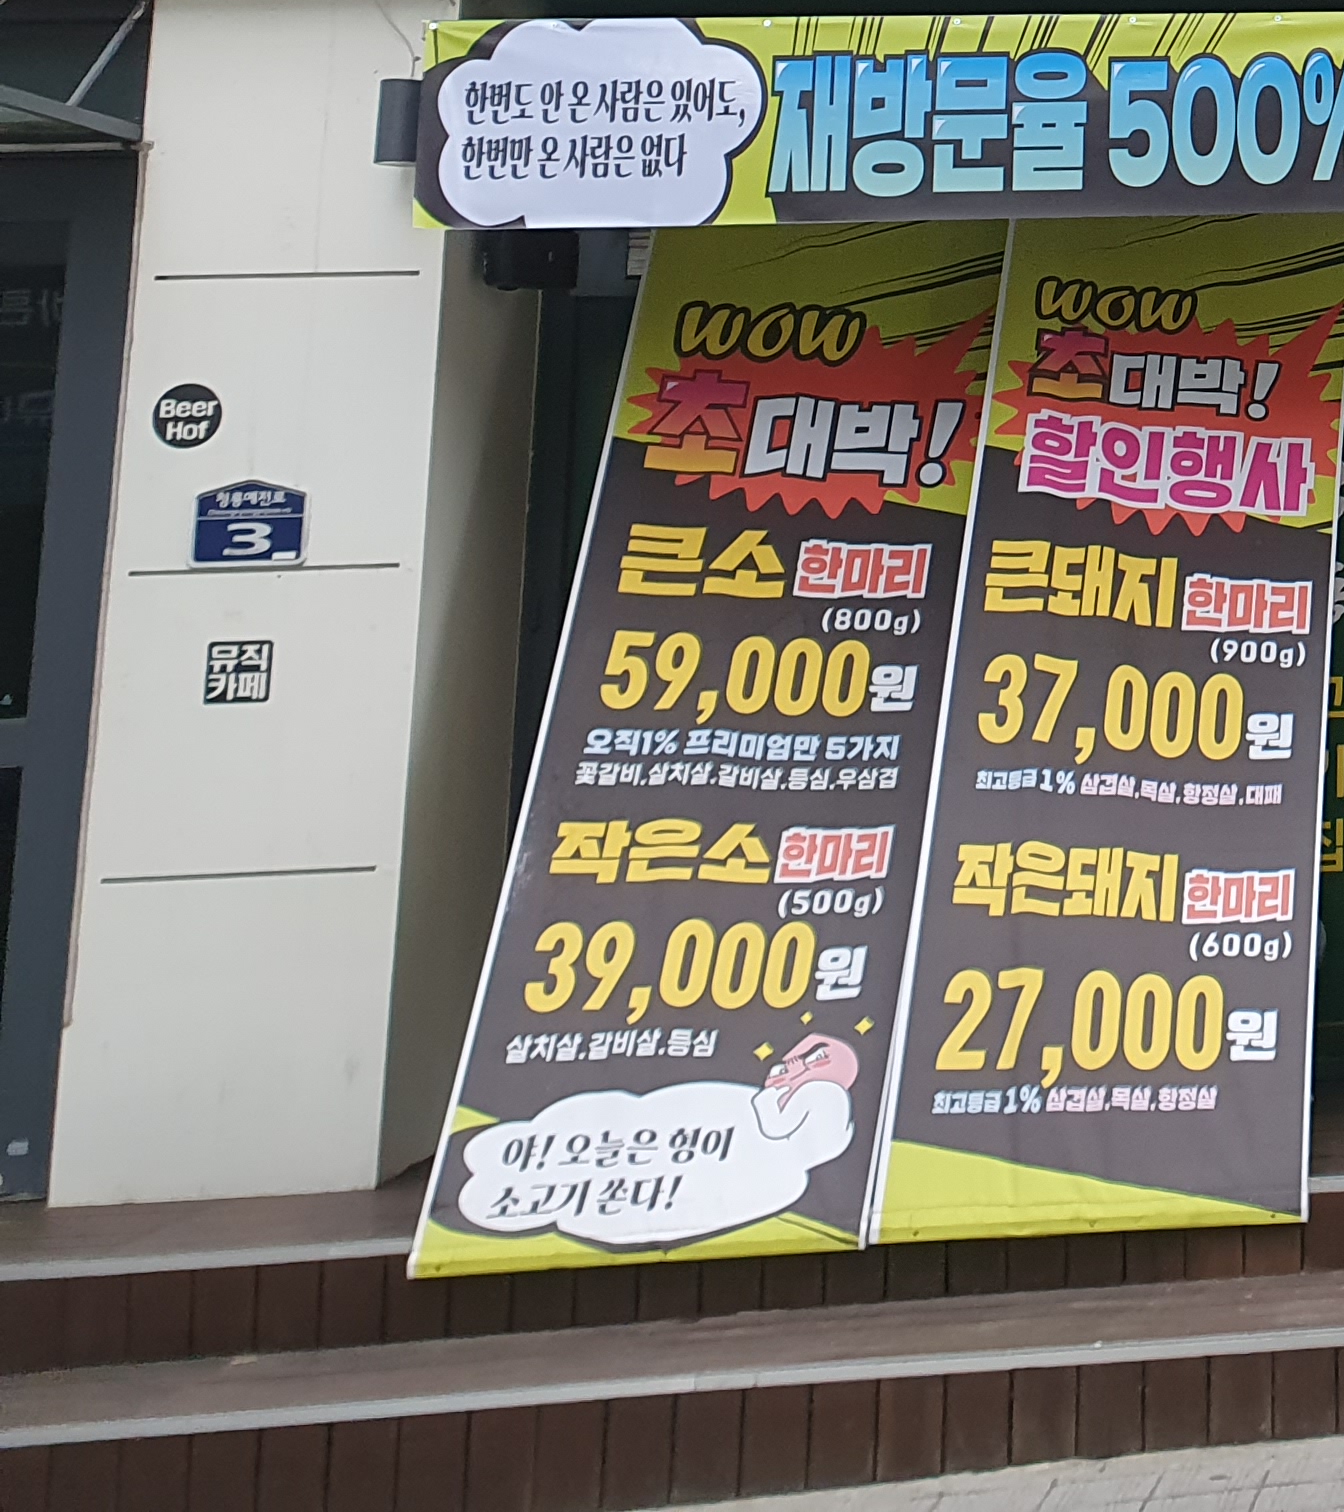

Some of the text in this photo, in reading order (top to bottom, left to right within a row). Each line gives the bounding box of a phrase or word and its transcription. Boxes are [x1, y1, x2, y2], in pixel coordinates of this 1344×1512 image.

[464, 80, 534, 126] 한번도
[539, 79, 564, 124] 안
[567, 80, 592, 124] 온
[592, 78, 667, 124] 사람은
[766, 48, 1089, 199] 재방문율
[461, 132, 688, 181] 한번만 온 사람은 없다
[1027, 327, 1281, 421] 초대박!
[158, 397, 219, 420] Beer
[165, 419, 210, 442] Hof
[643, 370, 966, 488] 초대박!
[1018, 409, 1317, 516] 할인행사
[222, 521, 273, 557] 3
[617, 522, 933, 599] 큰소 한마리
[983, 539, 1314, 635] 큰돼지 한마리
[821, 605, 922, 637] (800g)
[209, 642, 270, 672] 뮤직
[1209, 638, 1308, 670] (900g)
[207, 671, 268, 702] 카페
[683, 728, 822, 762] 프리미엄만
[824, 733, 901, 762] 5가지
[548, 817, 897, 885] 작은소 한마리
[777, 886, 886, 919] (500g)
[951, 840, 1297, 925] 작은돼지 한마리
[1188, 930, 1293, 962] (600g)
[501, 1125, 736, 1174] 야! 오늘은 형이
[485, 1177, 593, 1219] 소고기
